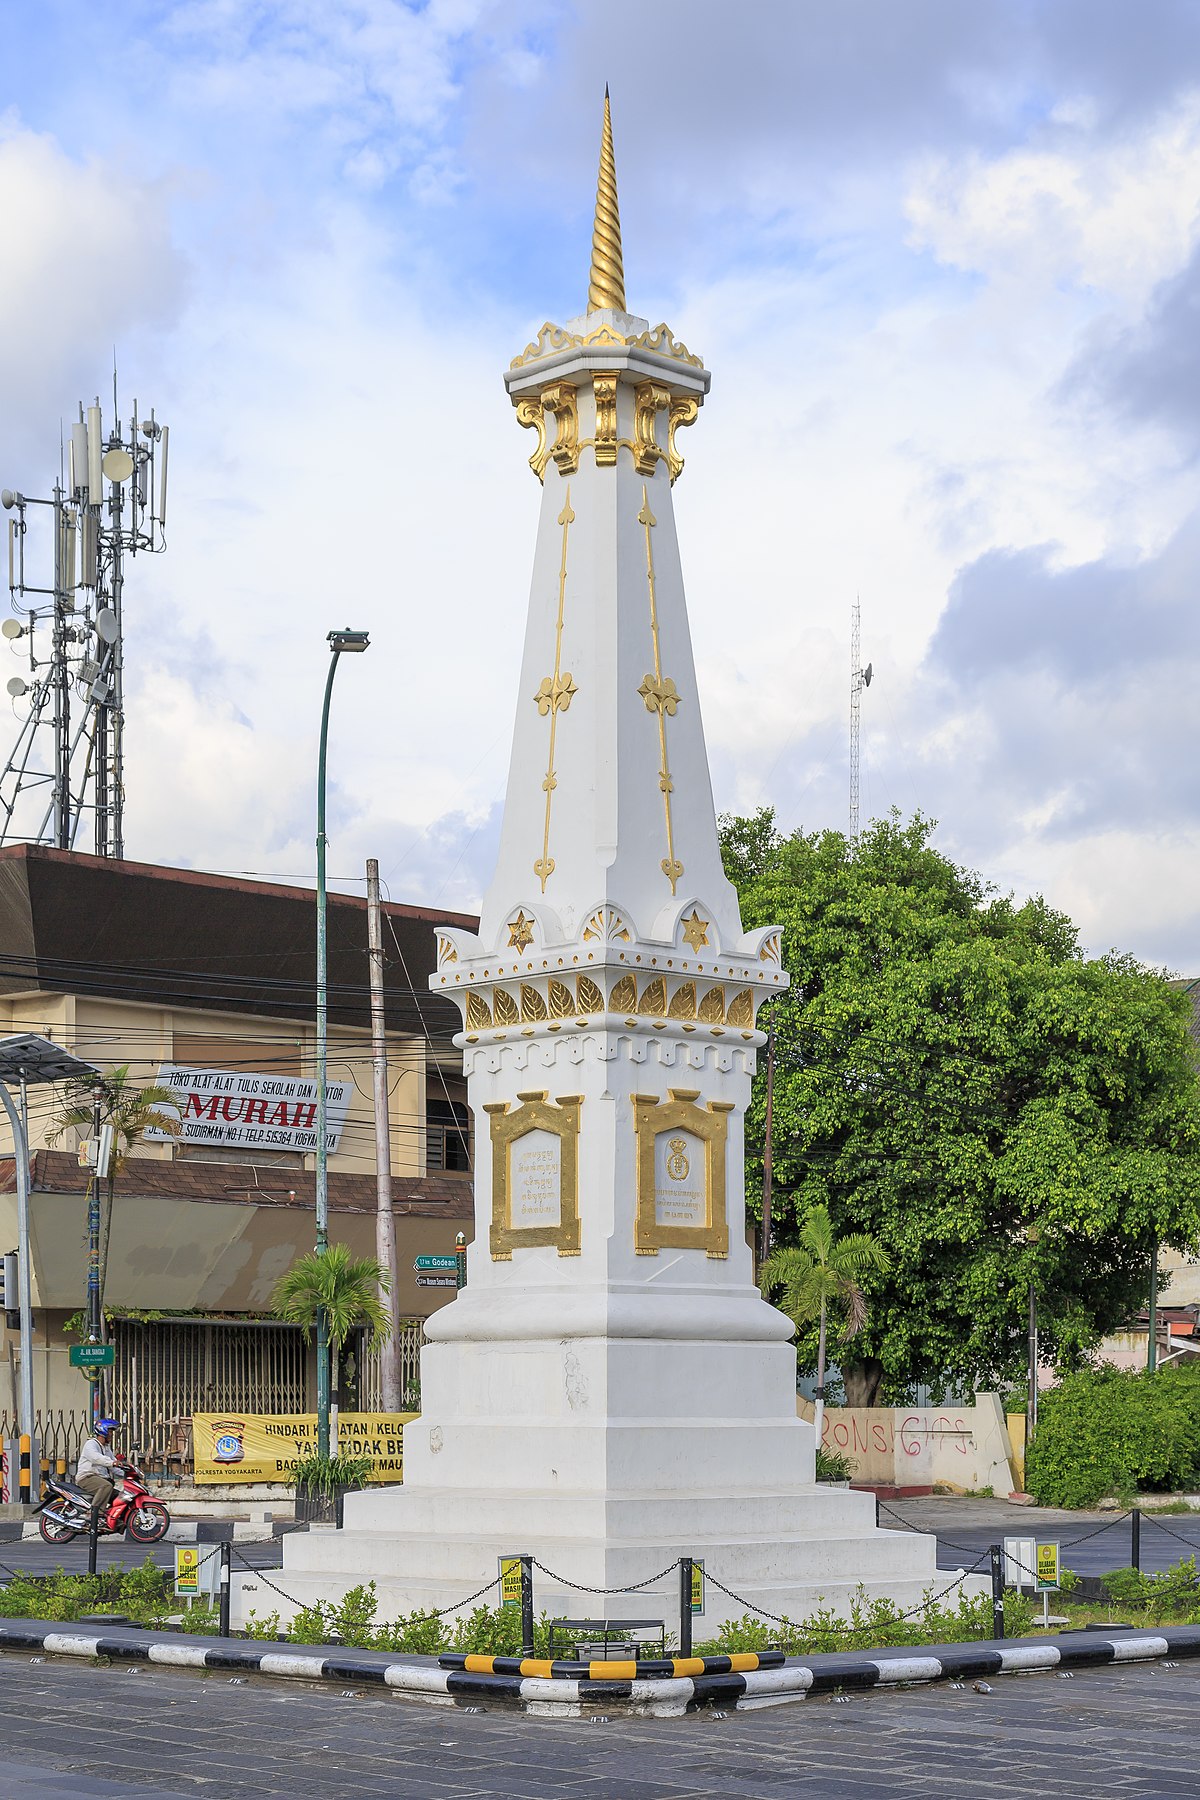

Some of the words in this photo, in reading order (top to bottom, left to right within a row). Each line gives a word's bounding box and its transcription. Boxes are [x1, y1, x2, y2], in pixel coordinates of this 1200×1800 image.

[169, 1072, 190, 1086] TOKO
[191, 1074, 235, 1091] ALAT-ALAT
[237, 1078, 260, 1093] TULIS
[261, 1081, 297, 1097] SEKOLAH
[297, 1084, 314, 1098] DAN
[182, 1092, 318, 1128] MURAH
[185, 1123, 226, 1140] SUDIRMAN
[265, 1130, 293, 1145] 515364
[432, 1258, 455, 1266] Godean
[265, 1424, 310, 1437] HINDARI
[337, 1439, 383, 1456] TIDAK
